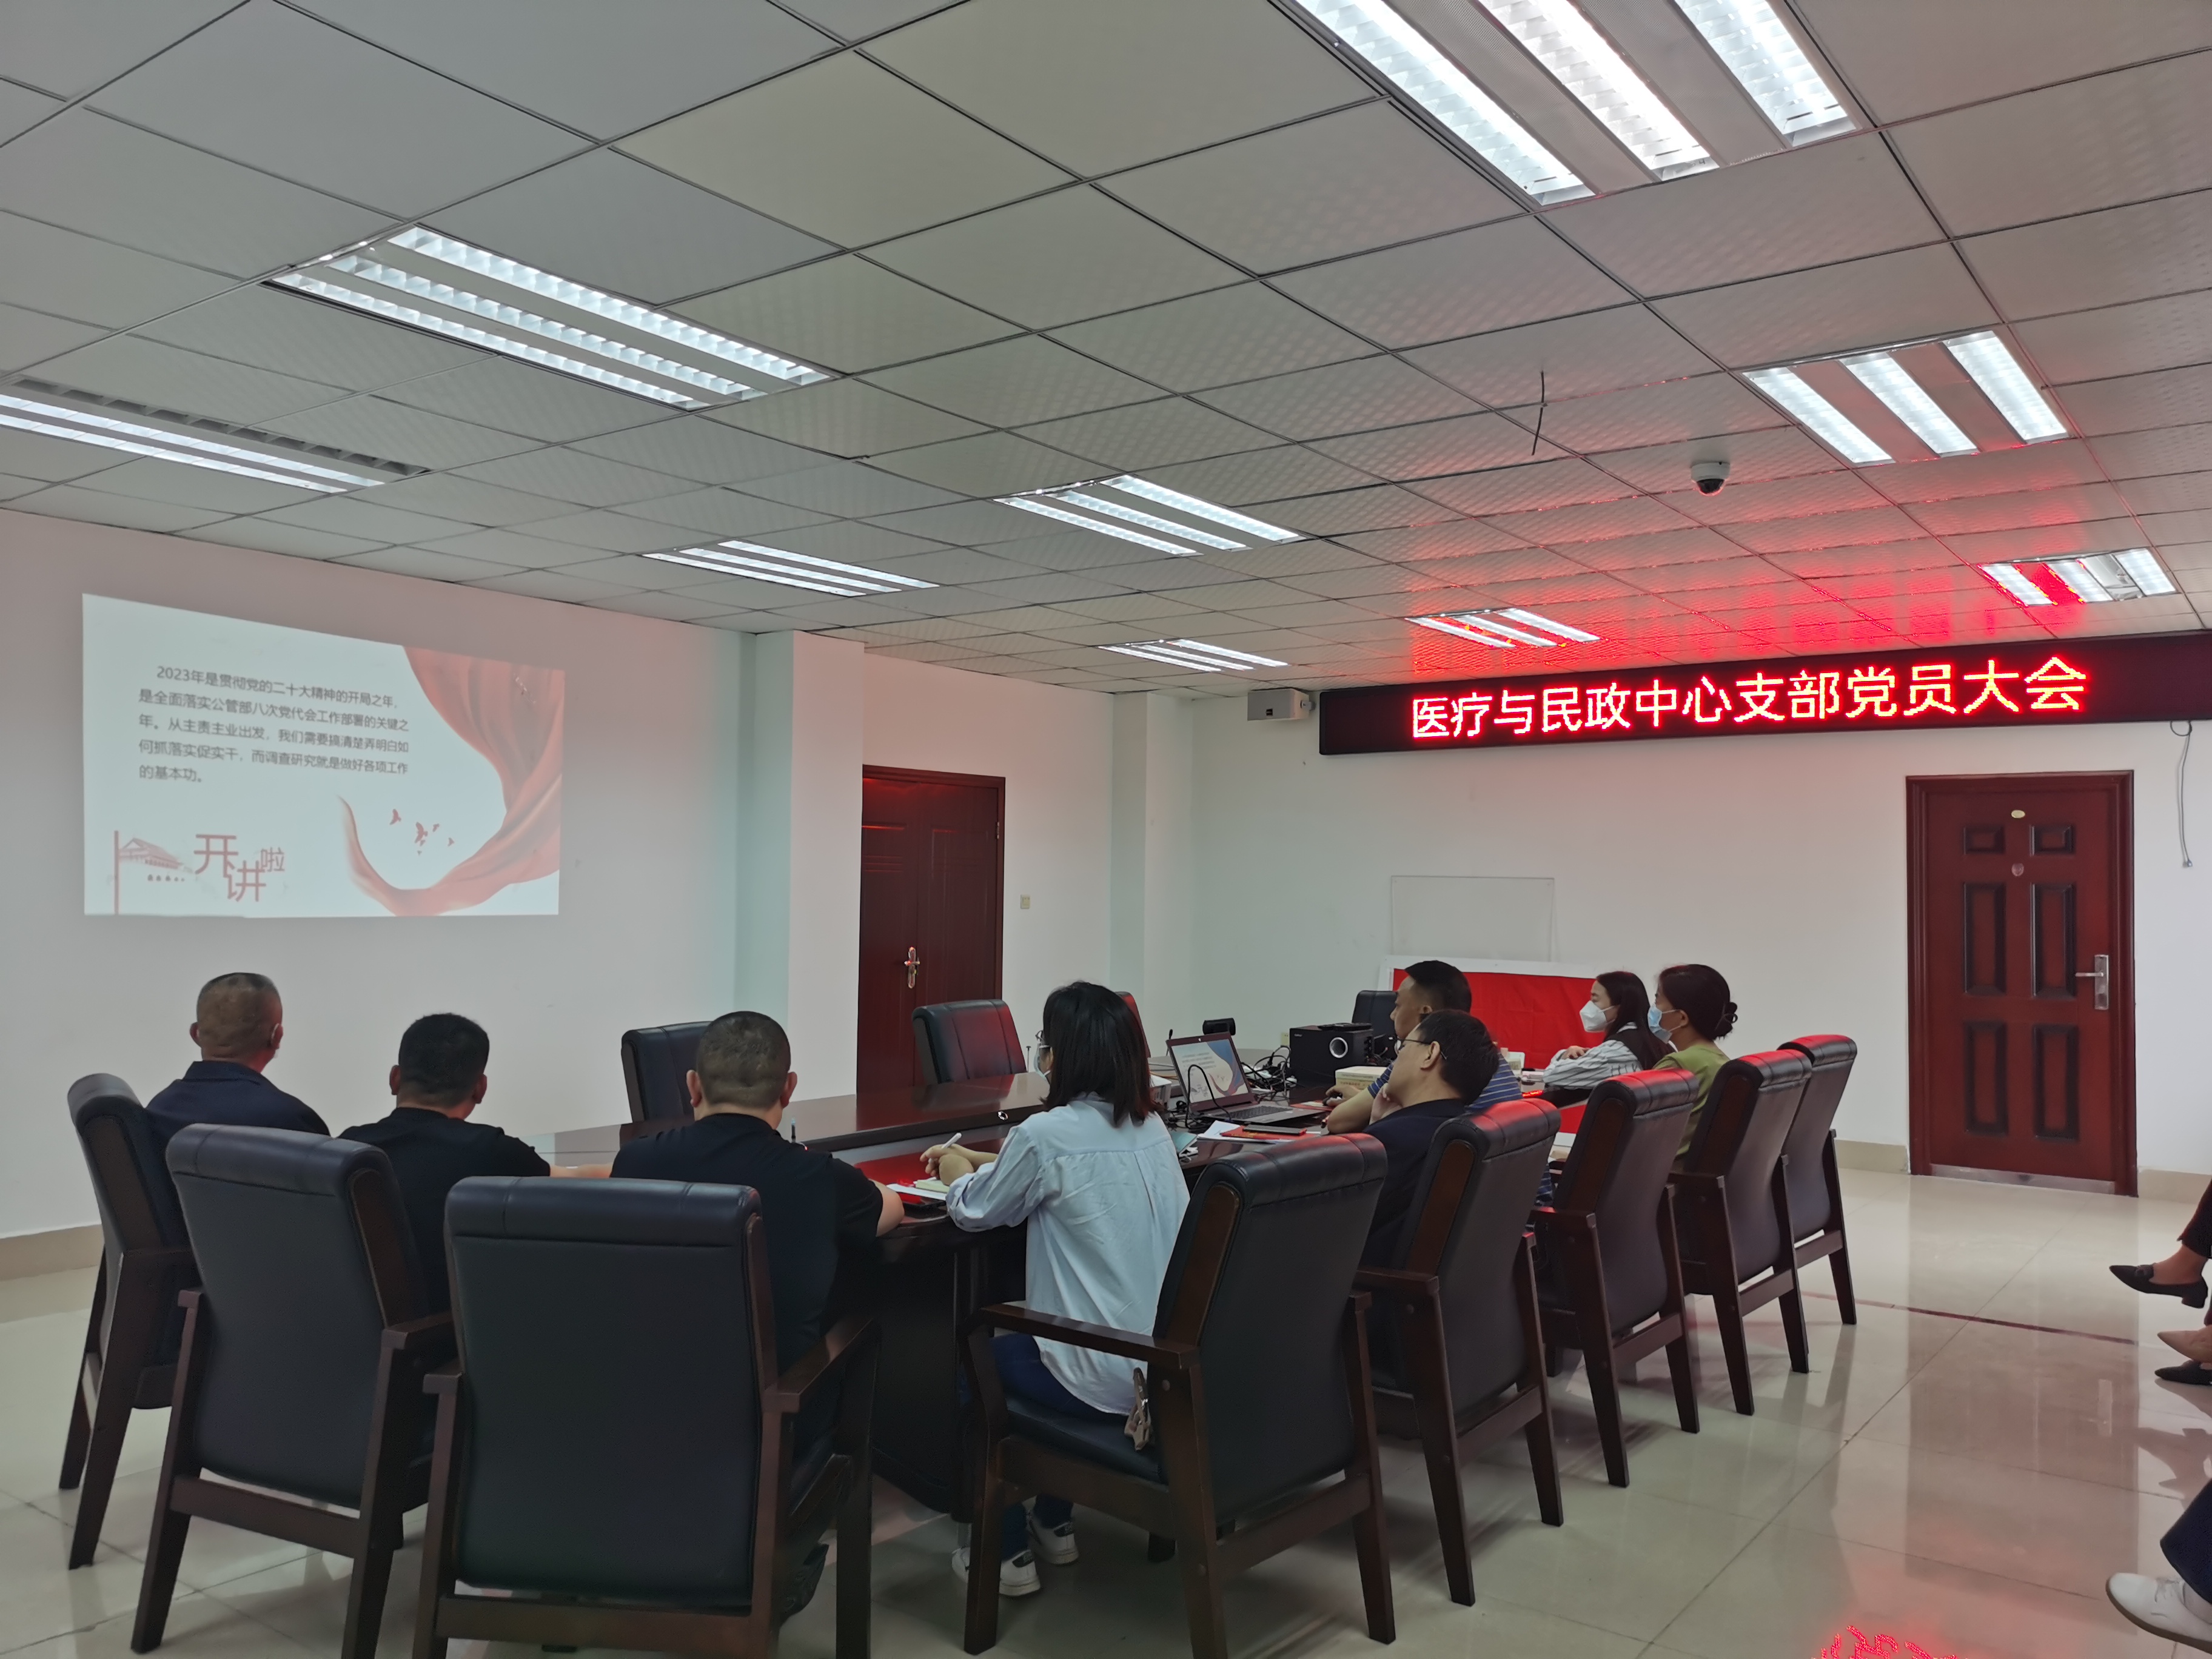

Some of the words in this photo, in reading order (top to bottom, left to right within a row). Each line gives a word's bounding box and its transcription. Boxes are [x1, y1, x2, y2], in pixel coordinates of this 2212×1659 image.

[1412, 657, 2086, 738] 医疗与民政中心支部党员大会
